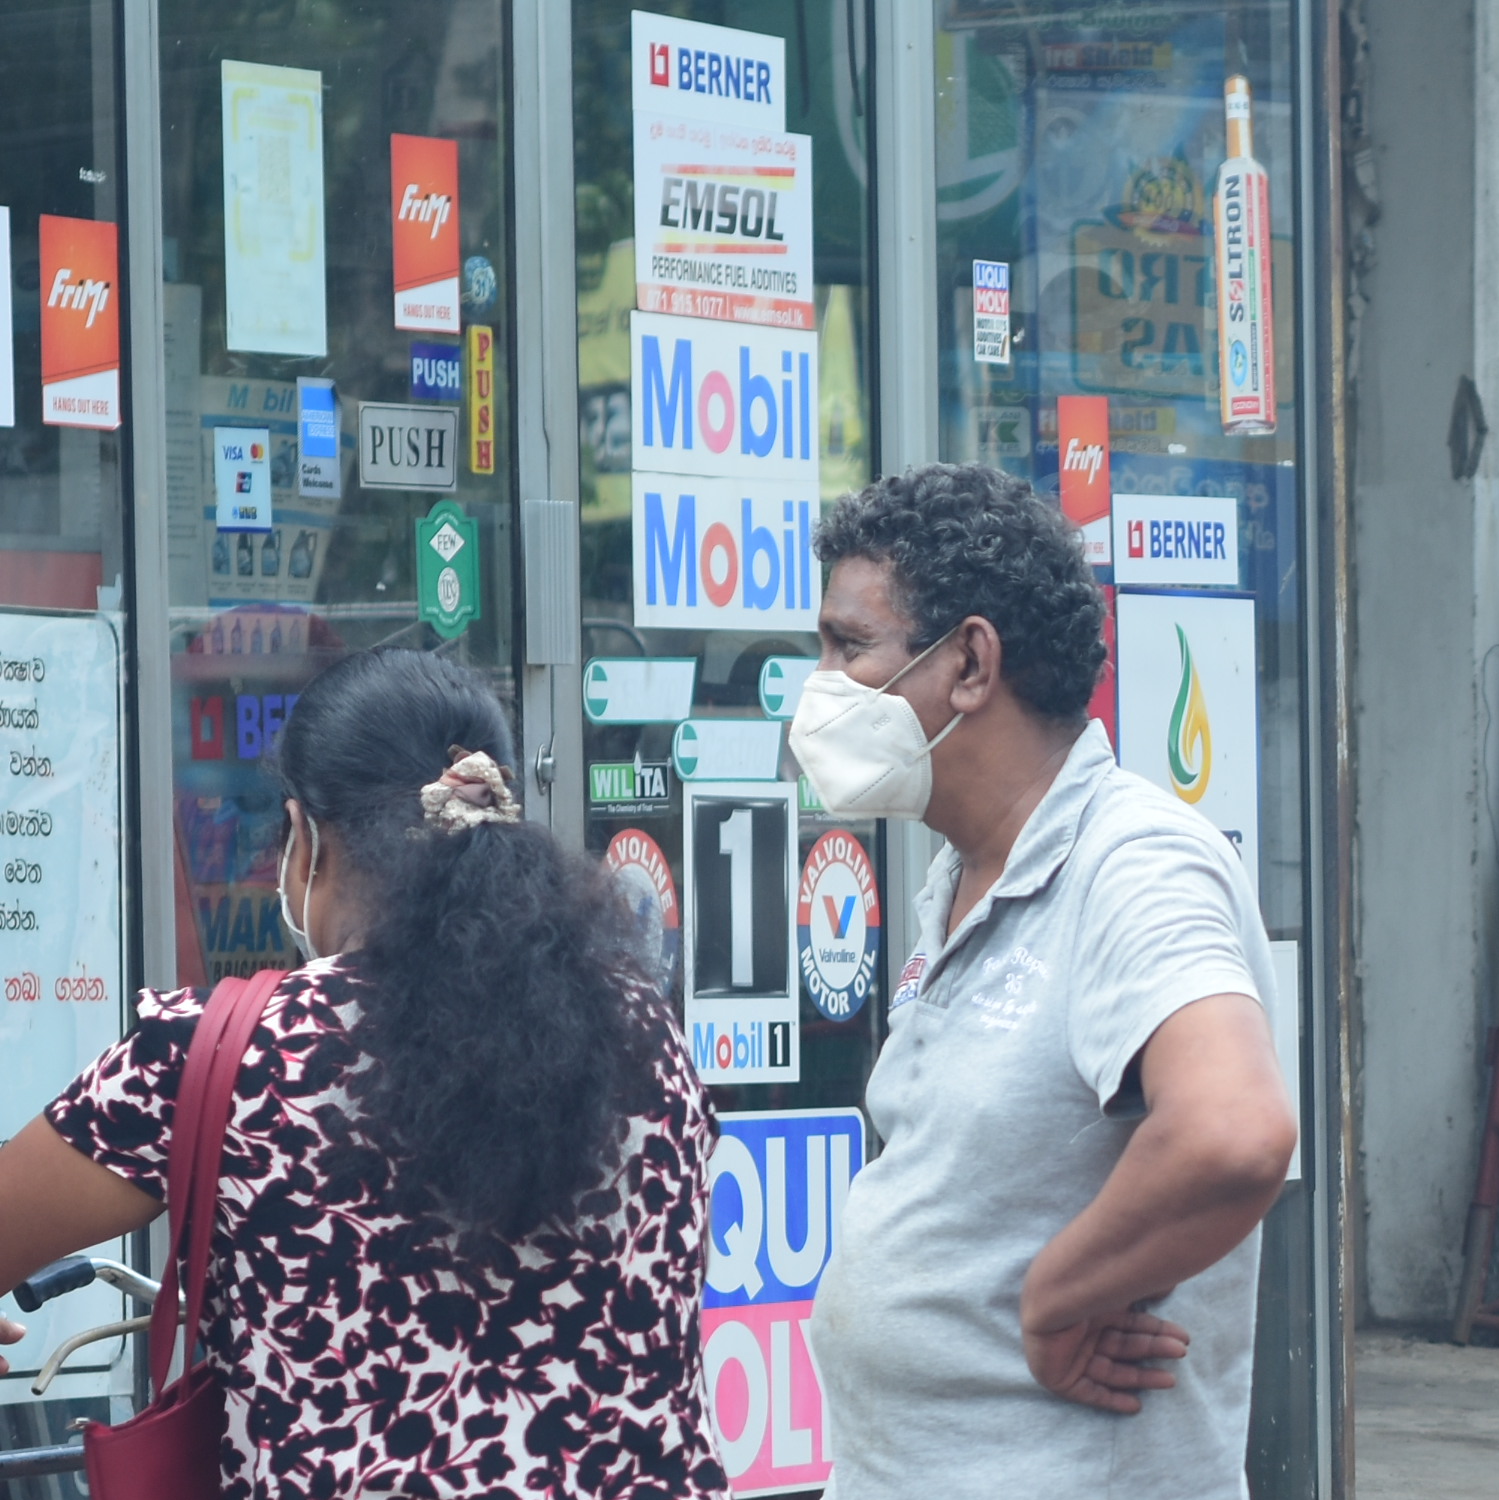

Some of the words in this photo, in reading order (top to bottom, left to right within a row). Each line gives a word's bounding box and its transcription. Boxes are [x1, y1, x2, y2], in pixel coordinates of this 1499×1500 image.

[678, 47, 772, 105] BERNER
[660, 176, 784, 241] EMSOL
[652, 255, 723, 285] PERFORMANCE
[725, 265, 748, 289] FUEL
[751, 268, 798, 294] ADDITIVES
[976, 264, 1007, 289] LIQUI
[47, 268, 111, 329] FriMi
[976, 289, 1008, 312] MOLY
[413, 356, 459, 388] PUSH
[53, 396, 76, 412] HANGS
[78, 398, 90, 413] OUT
[92, 400, 109, 415] HERE
[227, 384, 297, 414] Mbil
[477, 332, 492, 470] PUSH
[641, 335, 810, 460] Mobil
[223, 445, 243, 461] VISA
[370, 426, 446, 468] PUSH
[302, 464, 321, 475] Cards
[303, 478, 333, 489] Welcome
[644, 492, 811, 611] Mobil
[1150, 520, 1227, 560] BERNER
[800, 836, 877, 912] VALVOLINE
[718, 808, 754, 987] 1
[819, 948, 857, 964] Valvoline
[801, 945, 850, 1015] MOTOR
[854, 950, 876, 998] OIL
[692, 1022, 764, 1069] Mobil
[706, 1134, 849, 1299] QUI
